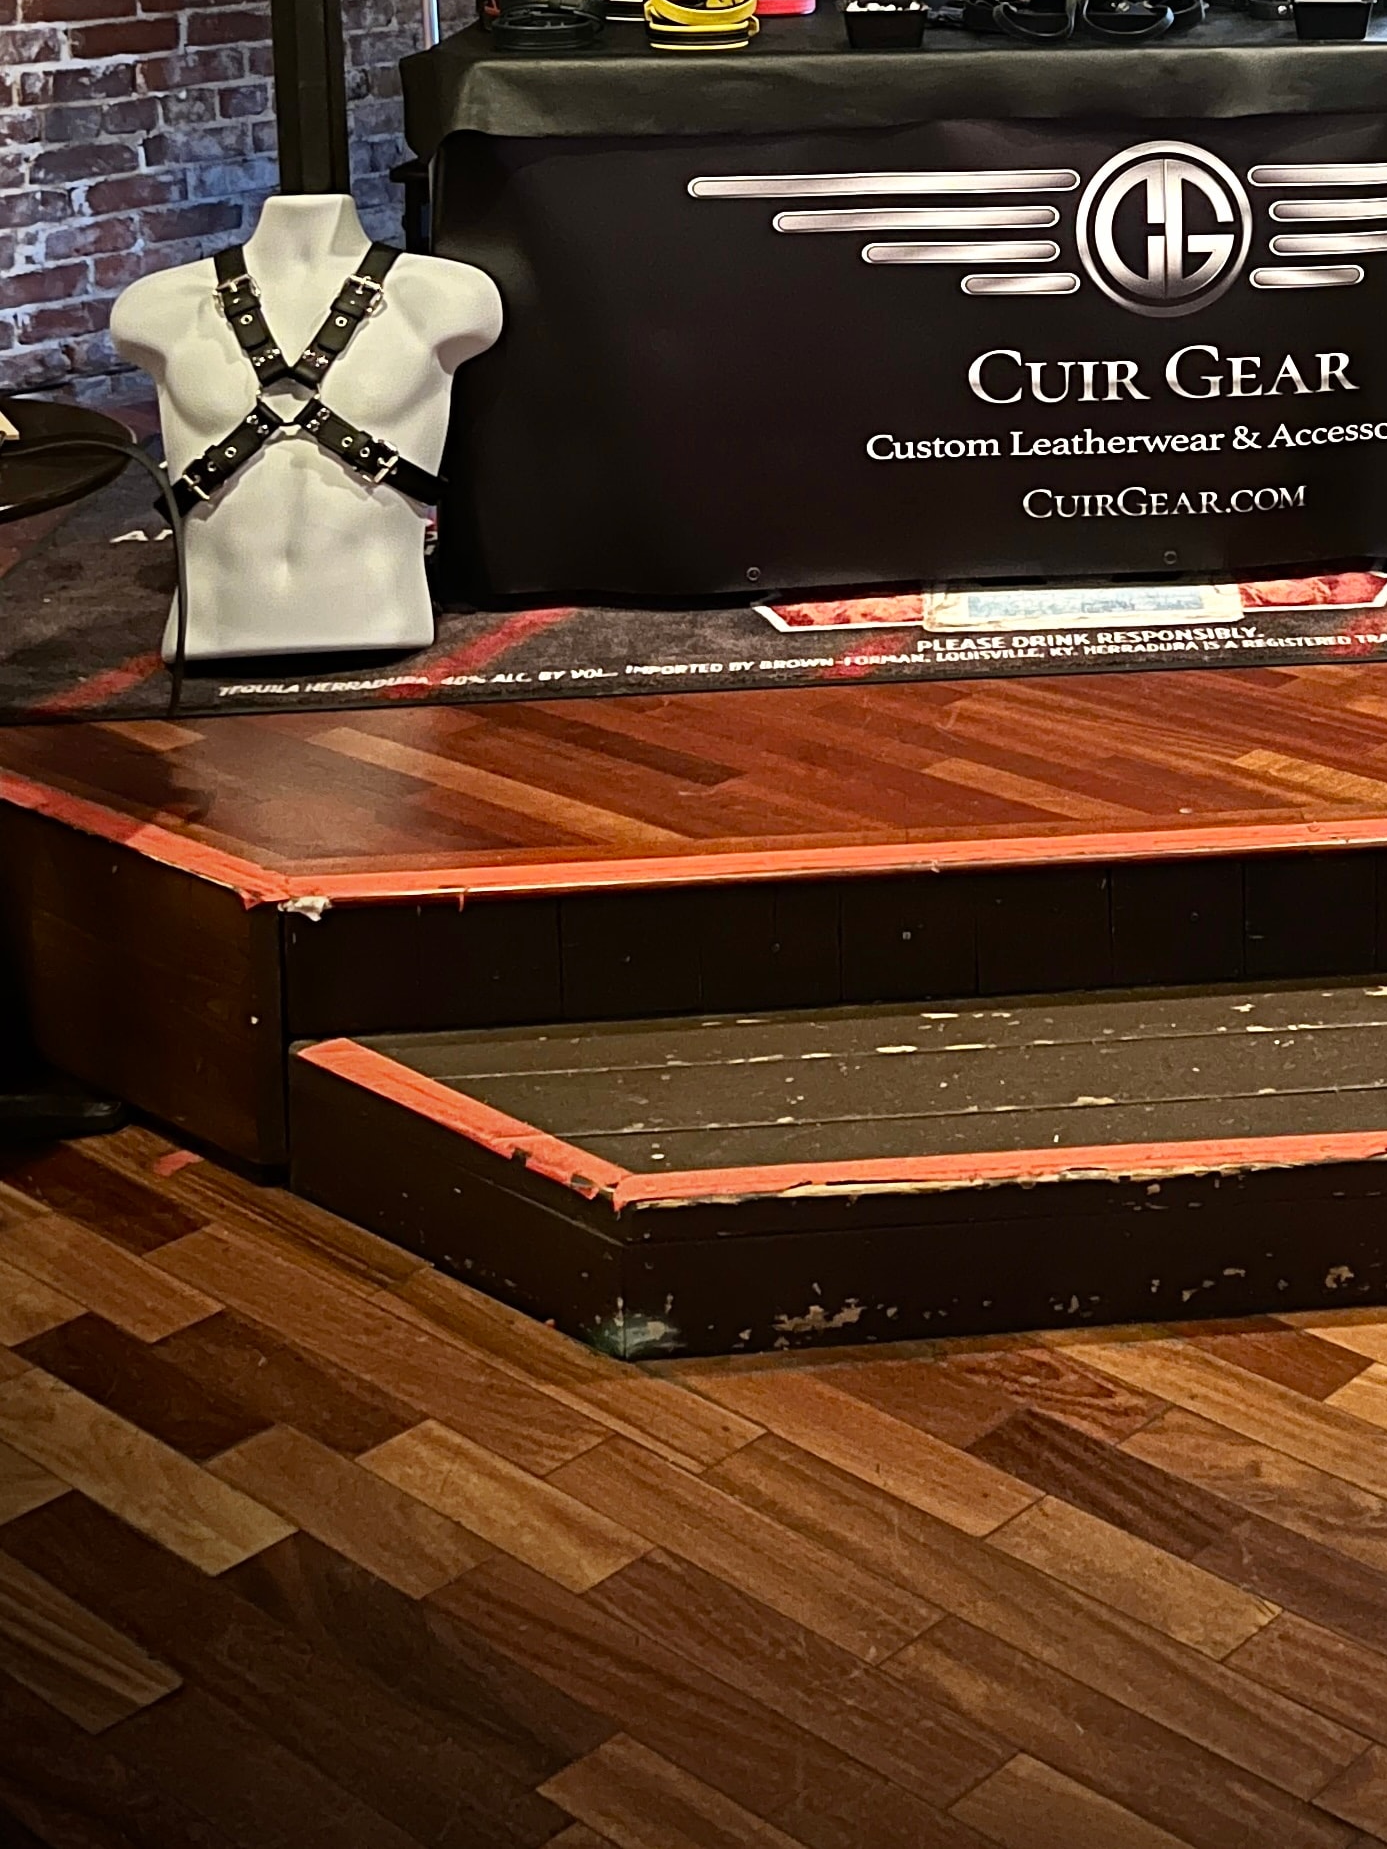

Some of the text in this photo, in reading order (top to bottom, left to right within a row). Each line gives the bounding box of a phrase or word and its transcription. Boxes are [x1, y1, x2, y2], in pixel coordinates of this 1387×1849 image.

[866, 434, 1001, 461] Custom
[1009, 428, 1226, 456] Leatherwear
[1232, 425, 1263, 450] &
[917, 627, 1265, 652] PLEASE DRINK RESPONSIBLY.
[218, 684, 299, 697] TEQUILA
[440, 675, 486, 686] 40%
[538, 671, 566, 681] BY
[625, 663, 723, 675] IMPORTED
[728, 661, 755, 673] BY
[1084, 641, 1198, 656] HERRADURA
[1203, 640, 1220, 651] IS
[1224, 639, 1239, 649] A
[1242, 635, 1352, 649] REGISTERED
